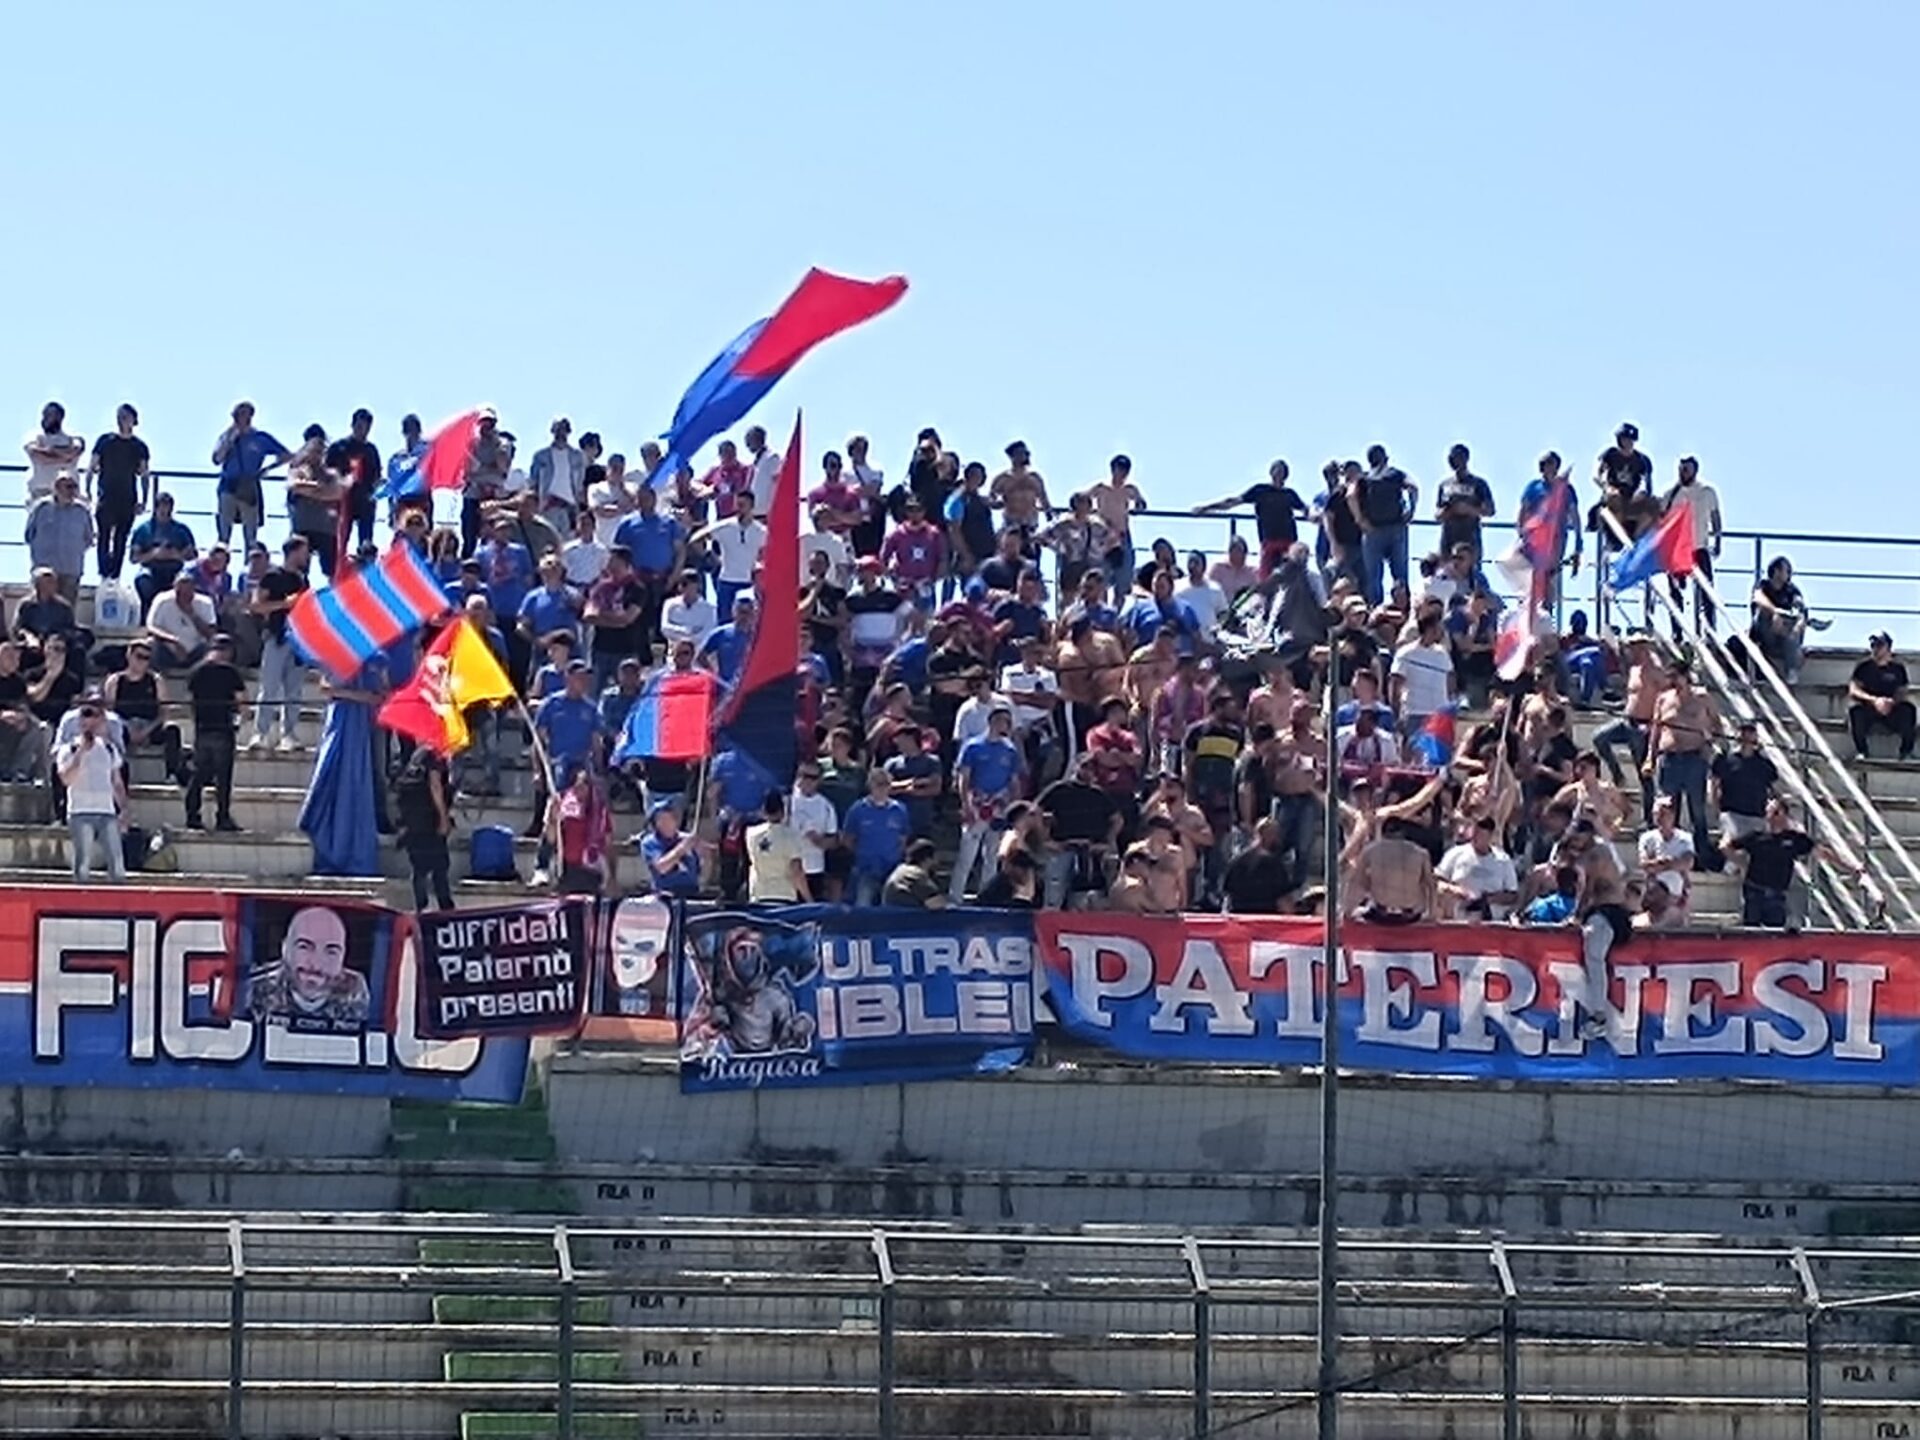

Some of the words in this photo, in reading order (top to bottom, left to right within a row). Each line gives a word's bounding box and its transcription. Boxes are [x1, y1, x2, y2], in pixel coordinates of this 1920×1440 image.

[823, 935, 1031, 979] ULTRAS
[440, 984, 575, 1026] presenti
[816, 981, 1031, 1039] IBLEI
[1056, 932, 1887, 1061] PATERNESI
[702, 1054, 821, 1087] Ragusa
[643, 1350, 677, 1366] FILA
[1842, 1366, 1875, 1382] FILA
[1877, 1422, 1909, 1438] FILA
